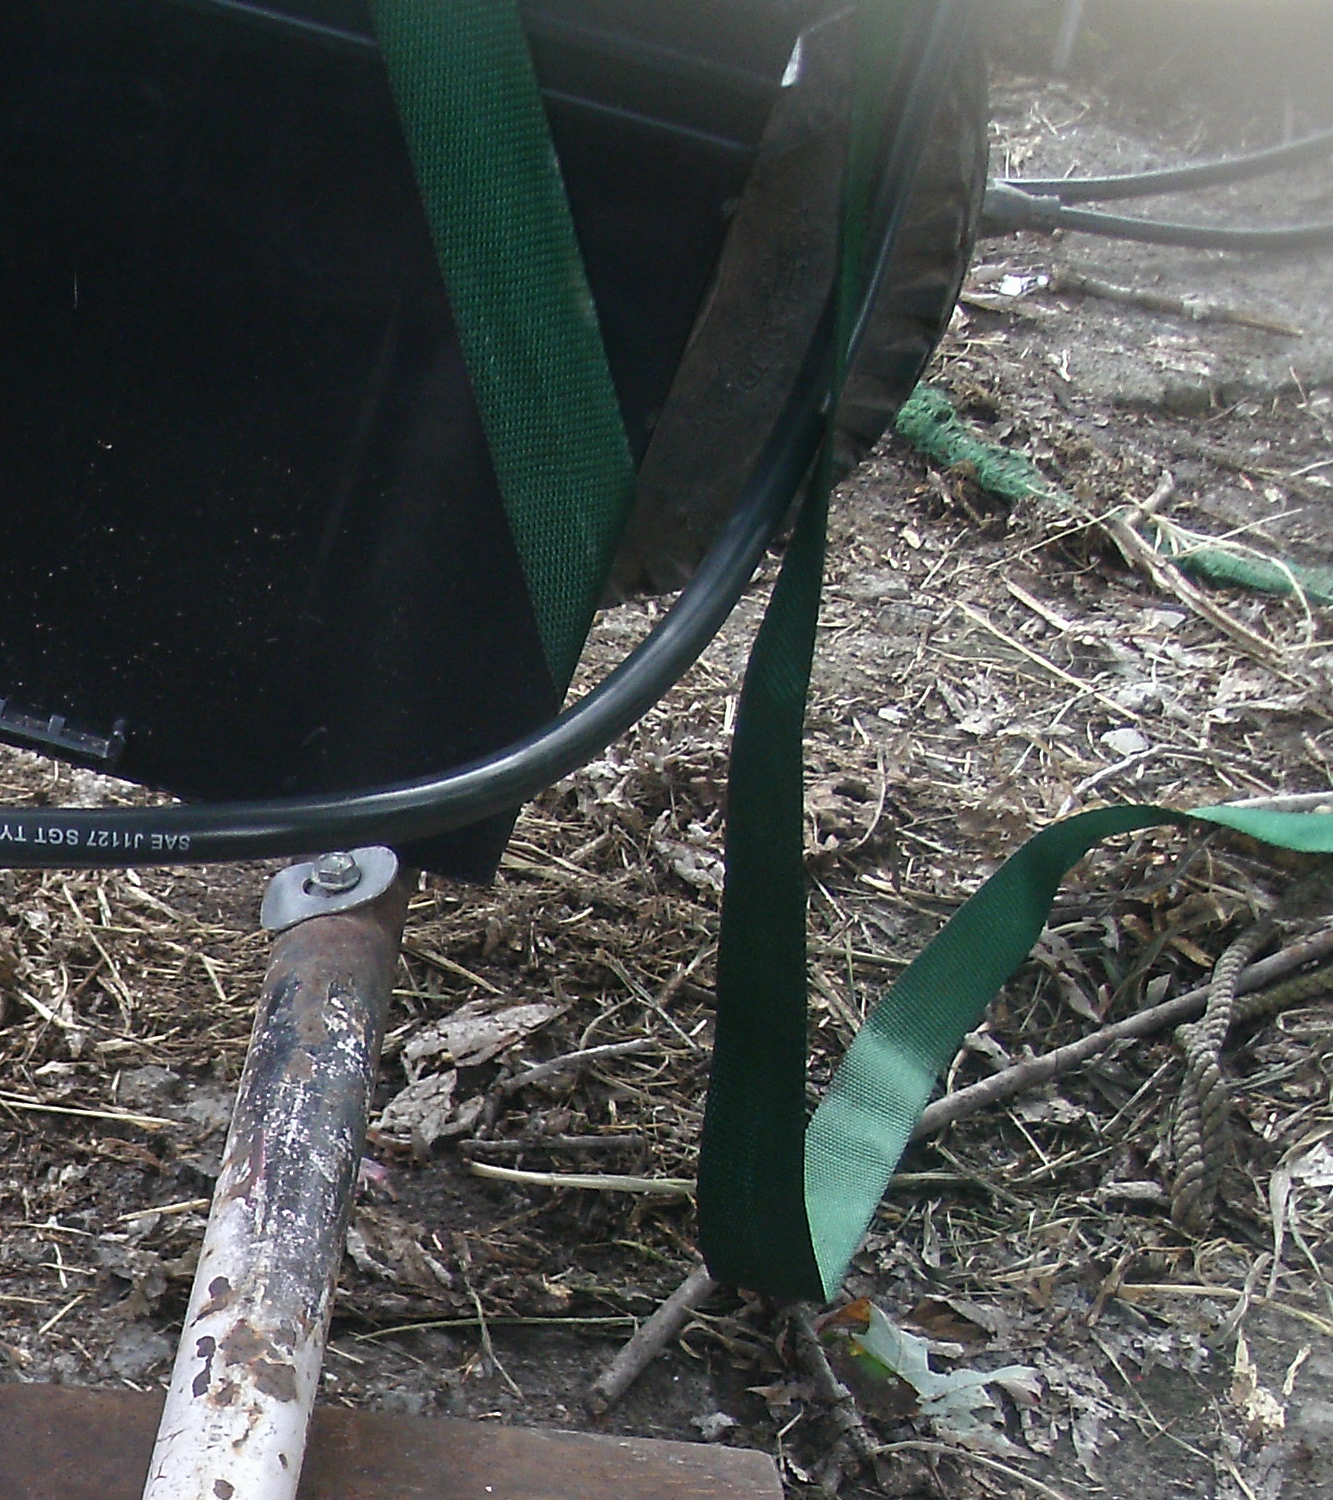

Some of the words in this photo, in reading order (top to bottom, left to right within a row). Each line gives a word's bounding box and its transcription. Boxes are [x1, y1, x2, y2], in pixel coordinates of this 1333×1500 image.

[34, 828, 80, 847] SGT
[87, 829, 144, 850] J1127
[150, 833, 191, 851] SAE
